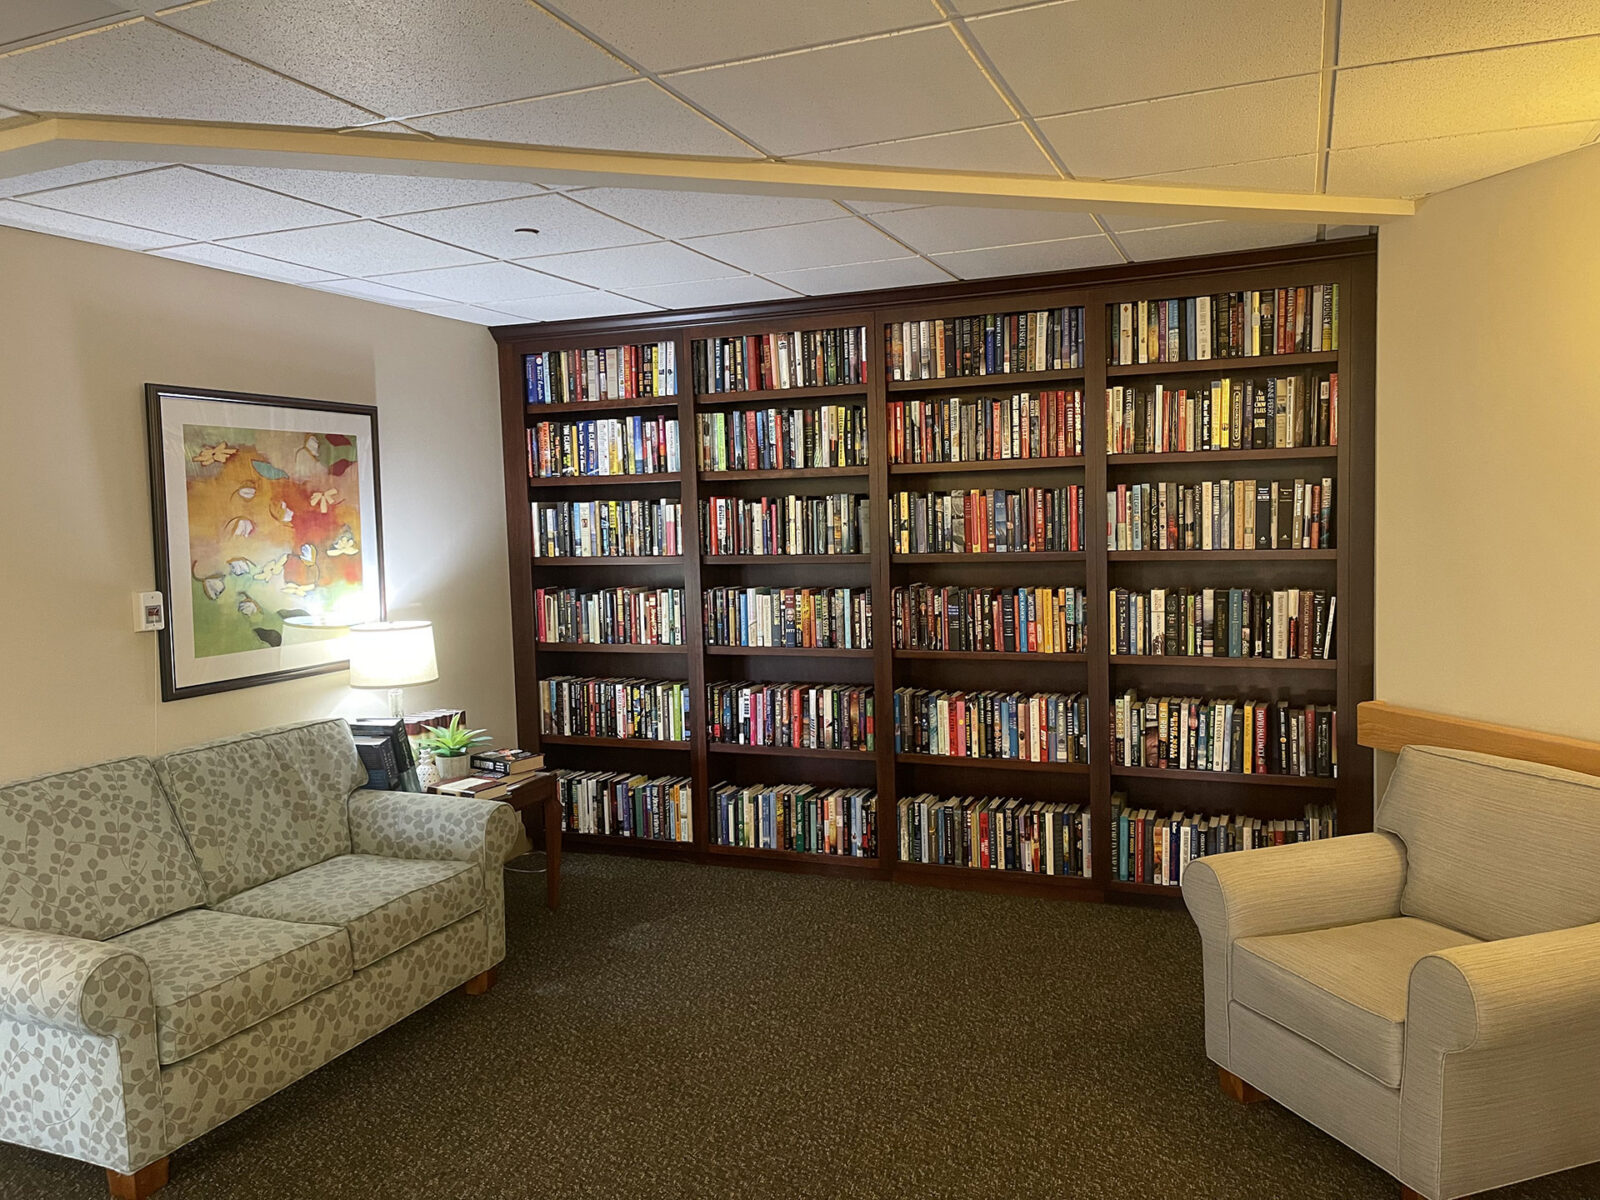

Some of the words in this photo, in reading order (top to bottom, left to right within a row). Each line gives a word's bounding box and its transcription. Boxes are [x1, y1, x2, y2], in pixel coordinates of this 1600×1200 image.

[1256, 395, 1264, 403] THE
[563, 436, 571, 454] CLANCY
[1257, 709, 1265, 728] DAVID
[1256, 728, 1265, 757] BALDACCI
